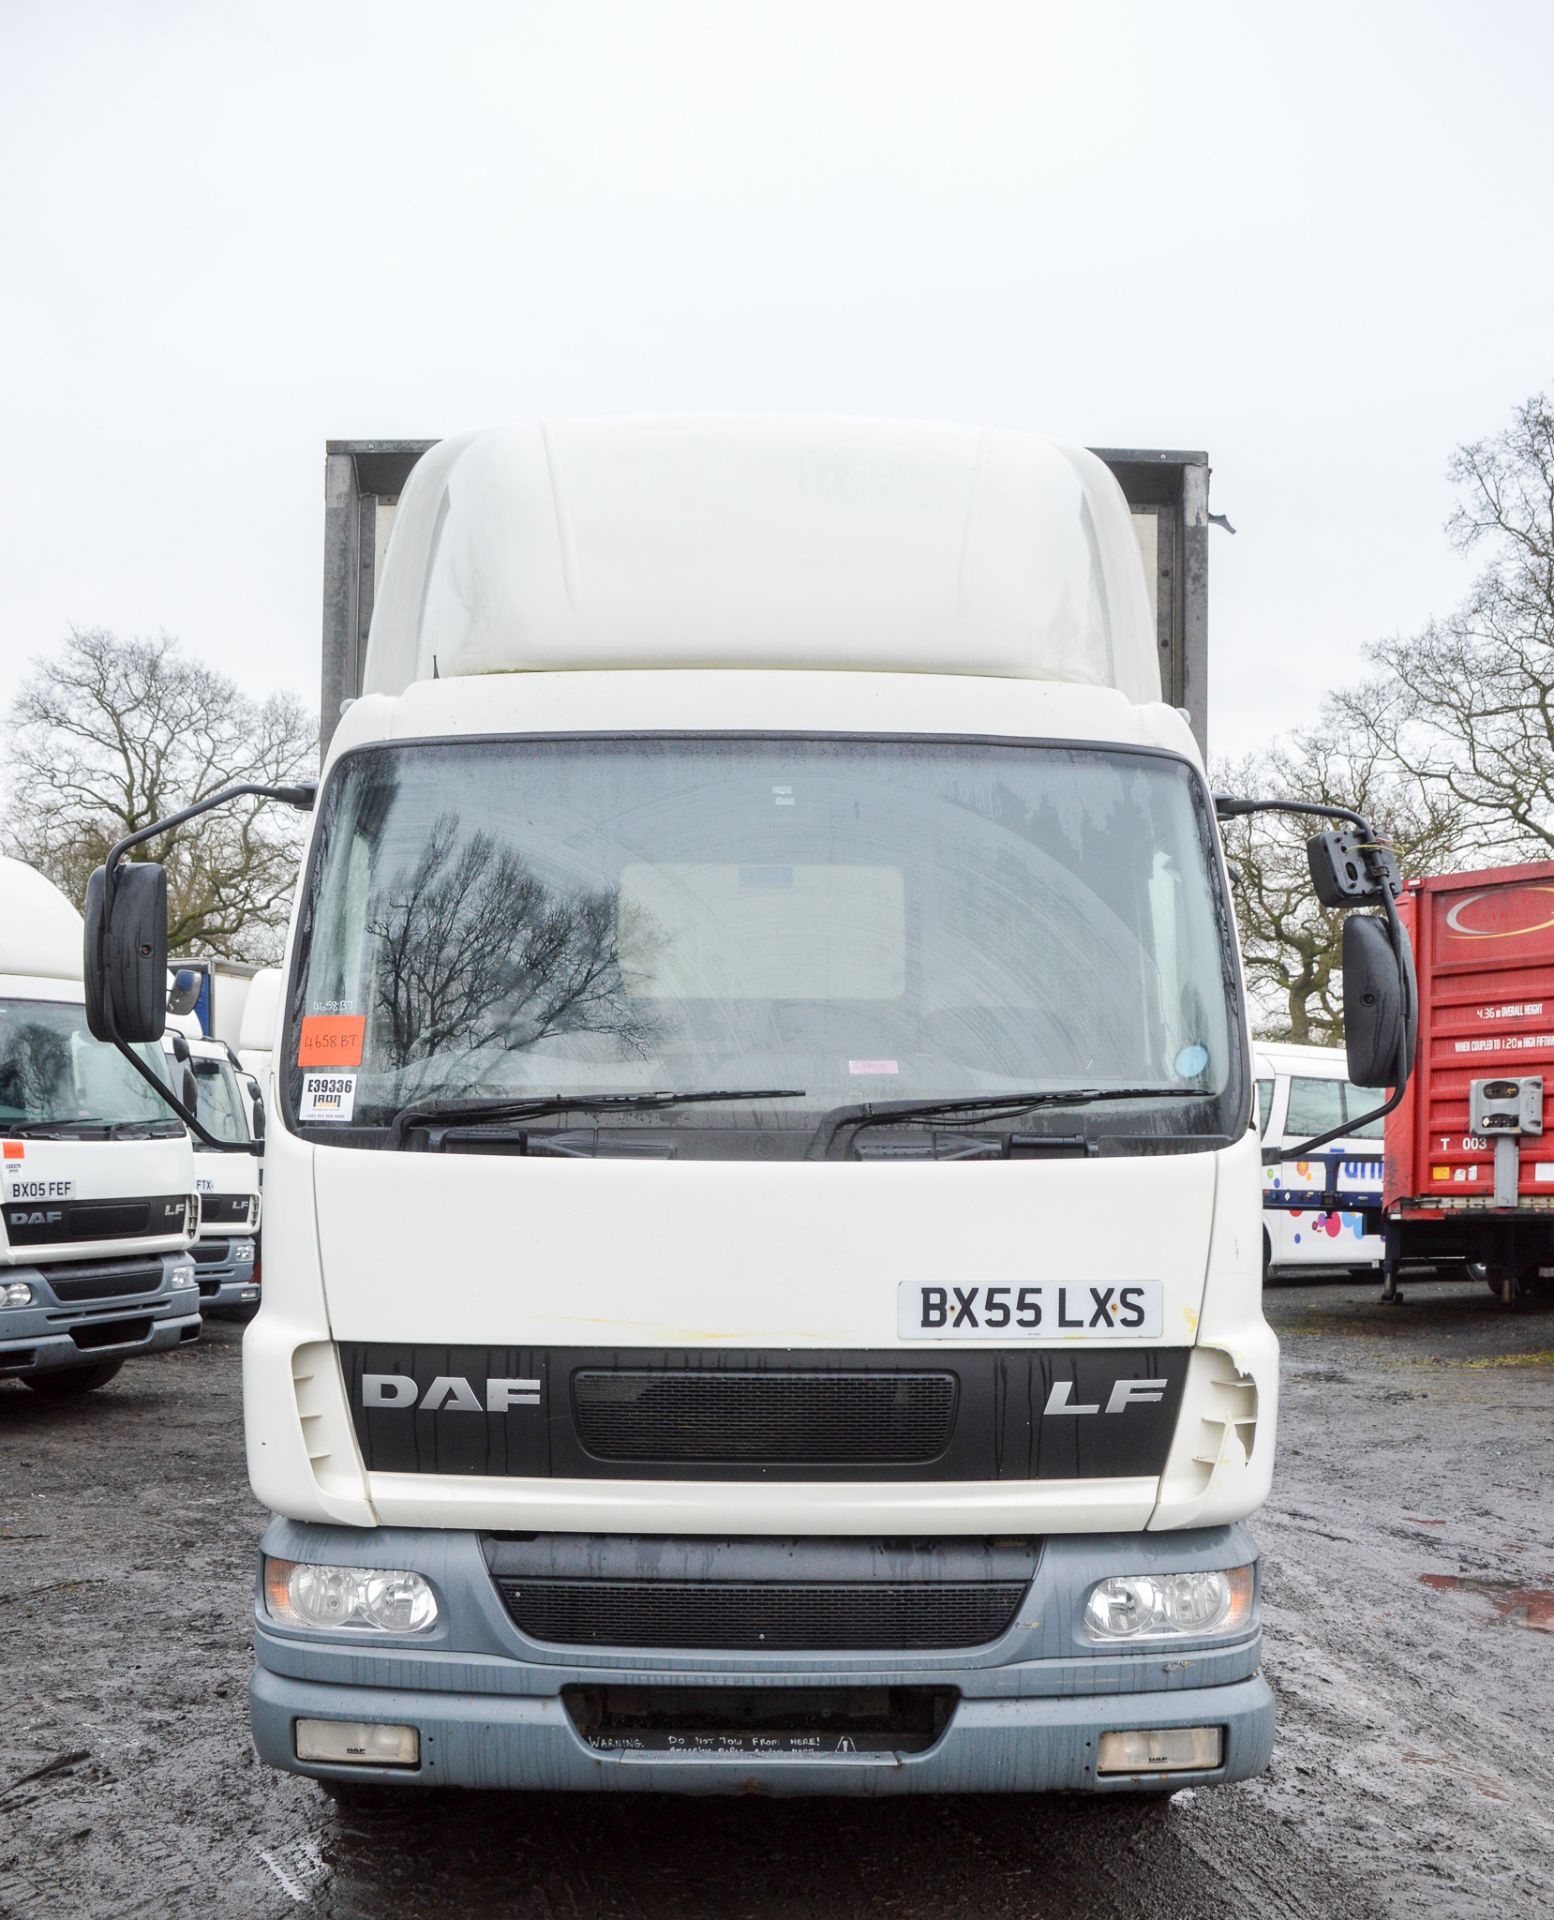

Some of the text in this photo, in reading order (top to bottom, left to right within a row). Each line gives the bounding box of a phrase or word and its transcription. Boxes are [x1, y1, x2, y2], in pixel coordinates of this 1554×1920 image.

[1477, 1008, 1495, 1019] 4.36
[305, 1034, 357, 1050] 4658 BT
[308, 1079, 352, 1093] E39336
[12, 1182, 71, 1197] BX05 FEF
[164, 1204, 185, 1216] LF
[232, 1200, 249, 1209] LF
[10, 1211, 62, 1225] DAF
[920, 1287, 1146, 1328] BX55 LXS
[362, 1374, 541, 1412] DAF
[1043, 1378, 1168, 1415] LF
